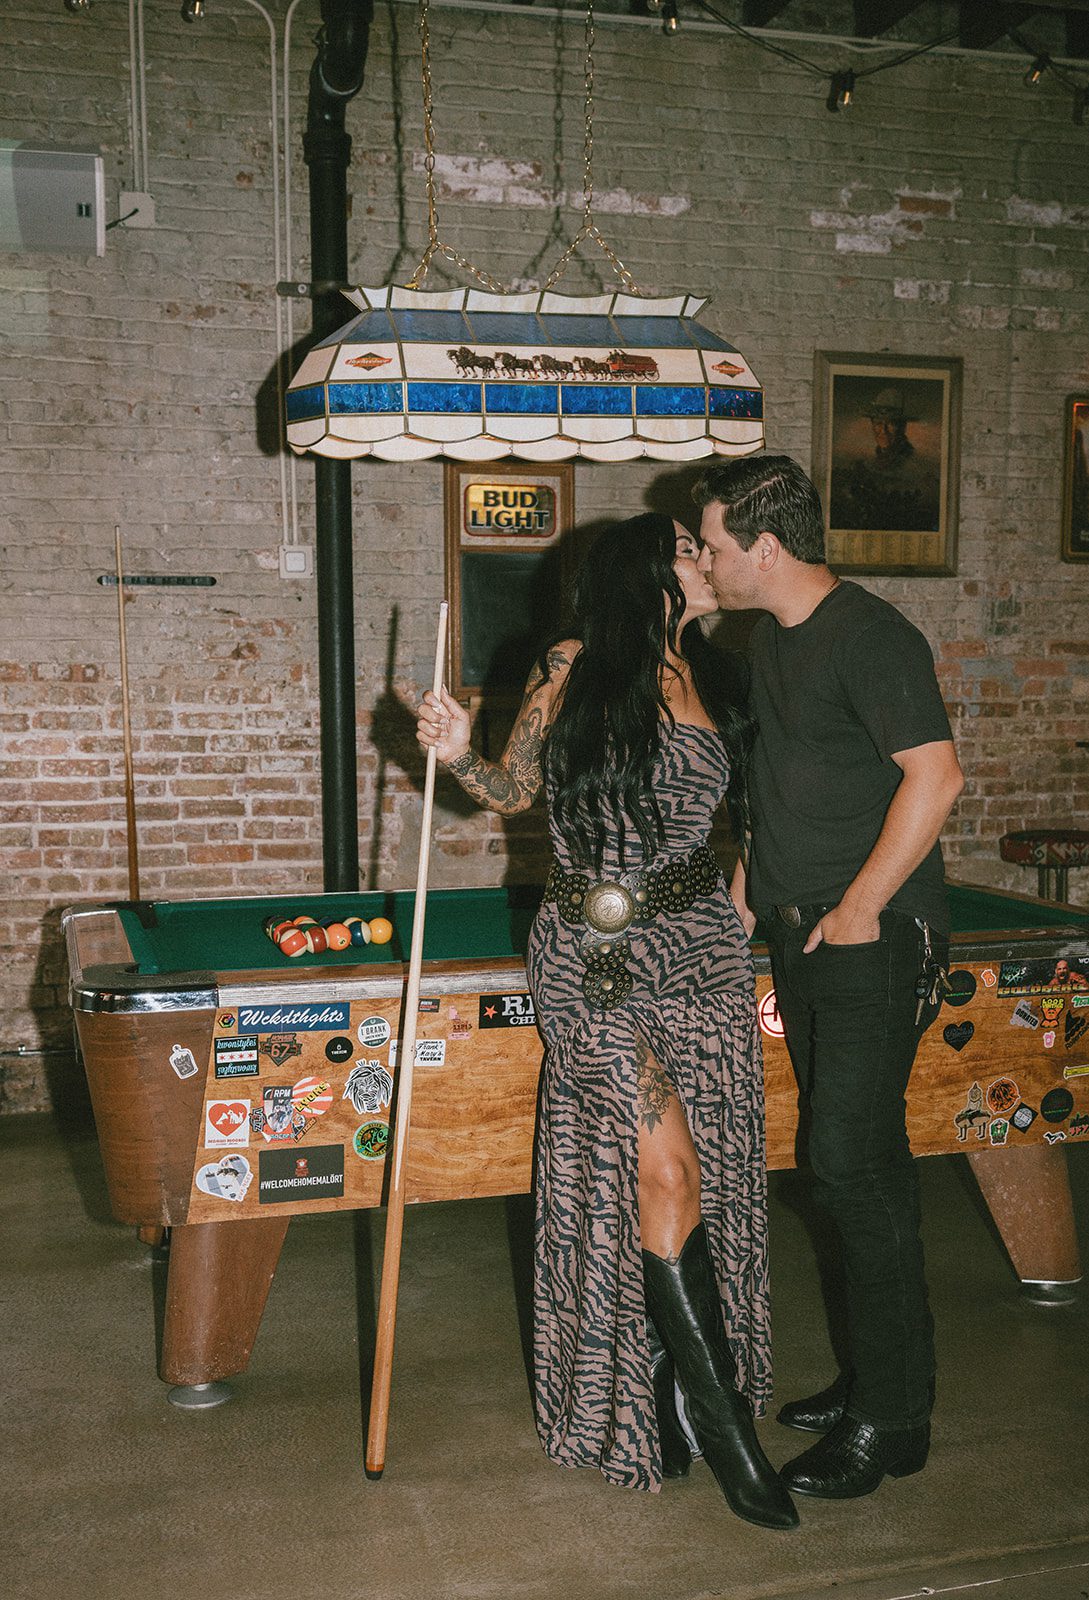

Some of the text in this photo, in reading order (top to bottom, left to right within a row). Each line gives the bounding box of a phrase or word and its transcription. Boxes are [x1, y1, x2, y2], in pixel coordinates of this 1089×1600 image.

[483, 490, 538, 508] BUD
[470, 510, 550, 529] LIGHT
[271, 1042, 291, 1058] 67
[273, 1088, 292, 1098] RPM
[261, 1174, 344, 1190] #WELCOMEHOMEMALÖRT
